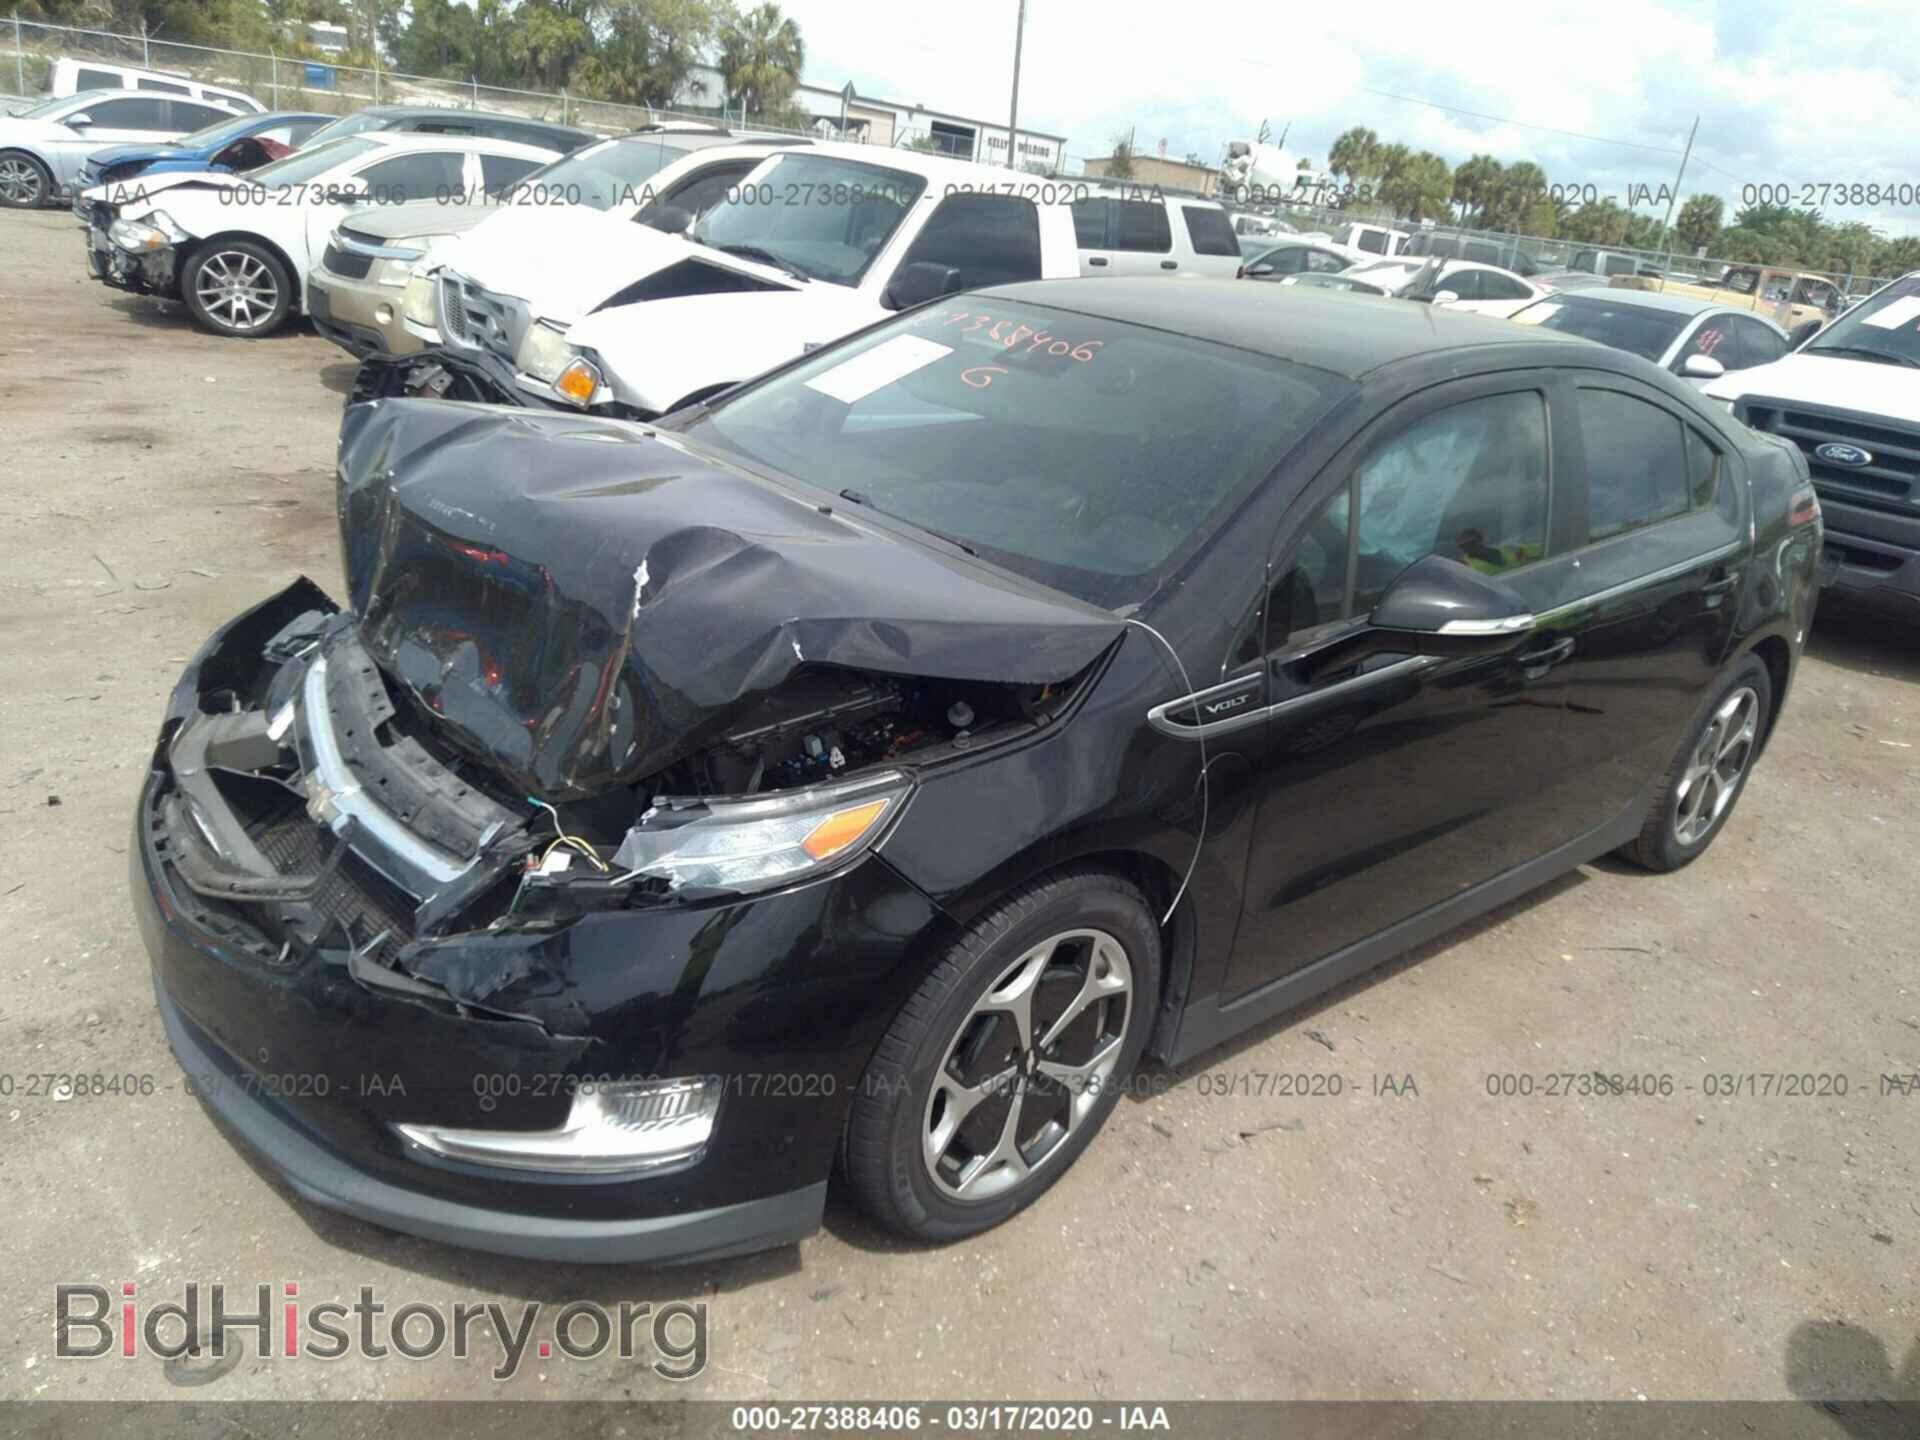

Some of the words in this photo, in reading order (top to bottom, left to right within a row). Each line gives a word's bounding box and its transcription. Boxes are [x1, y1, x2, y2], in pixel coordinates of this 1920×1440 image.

[987, 135, 1009, 150] KELLY
[1017, 142, 1050, 158] WELDING
[914, 309, 1104, 362] 7388406
[1205, 694, 1249, 714] VOLT
